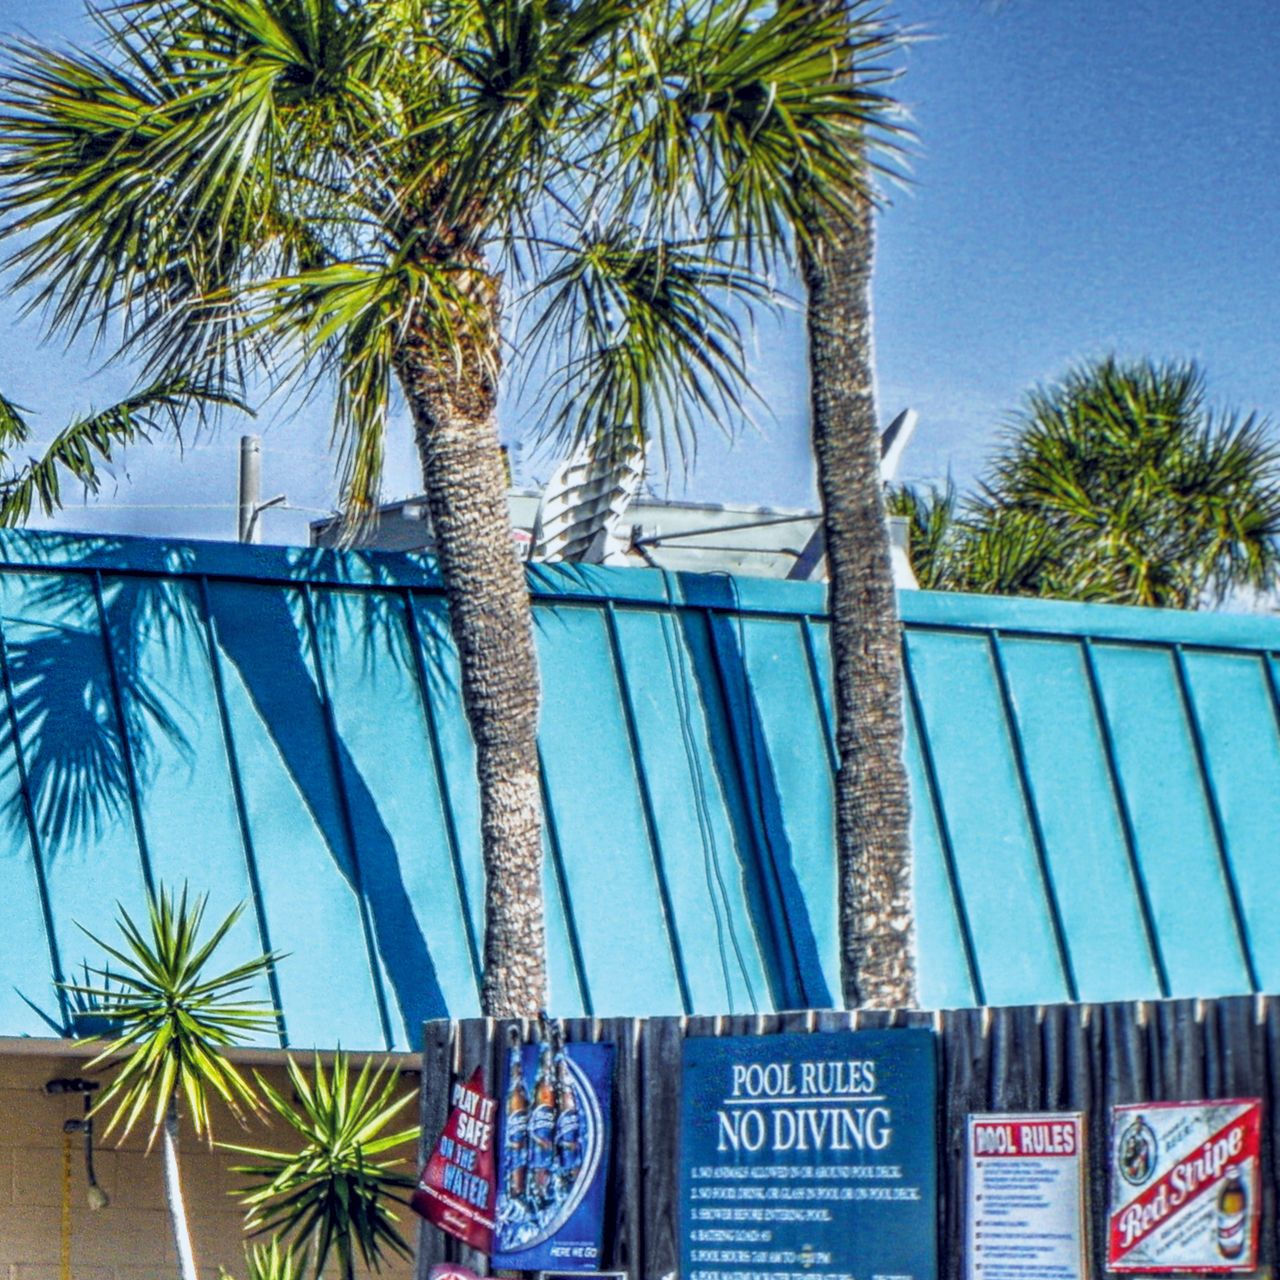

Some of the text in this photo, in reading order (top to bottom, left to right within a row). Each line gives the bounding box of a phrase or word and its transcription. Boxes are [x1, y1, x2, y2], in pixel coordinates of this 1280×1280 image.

[732, 1061, 875, 1096] POOL RULES
[452, 1083, 493, 1122] PLAY IT
[456, 1113, 490, 1150] SAFE
[717, 1108, 892, 1151] NO DIVING
[1021, 1124, 1075, 1153] RULES
[443, 1164, 489, 1209] WATER
[1118, 1184, 1169, 1248] Red
[1169, 1126, 1245, 1206] Stripe
